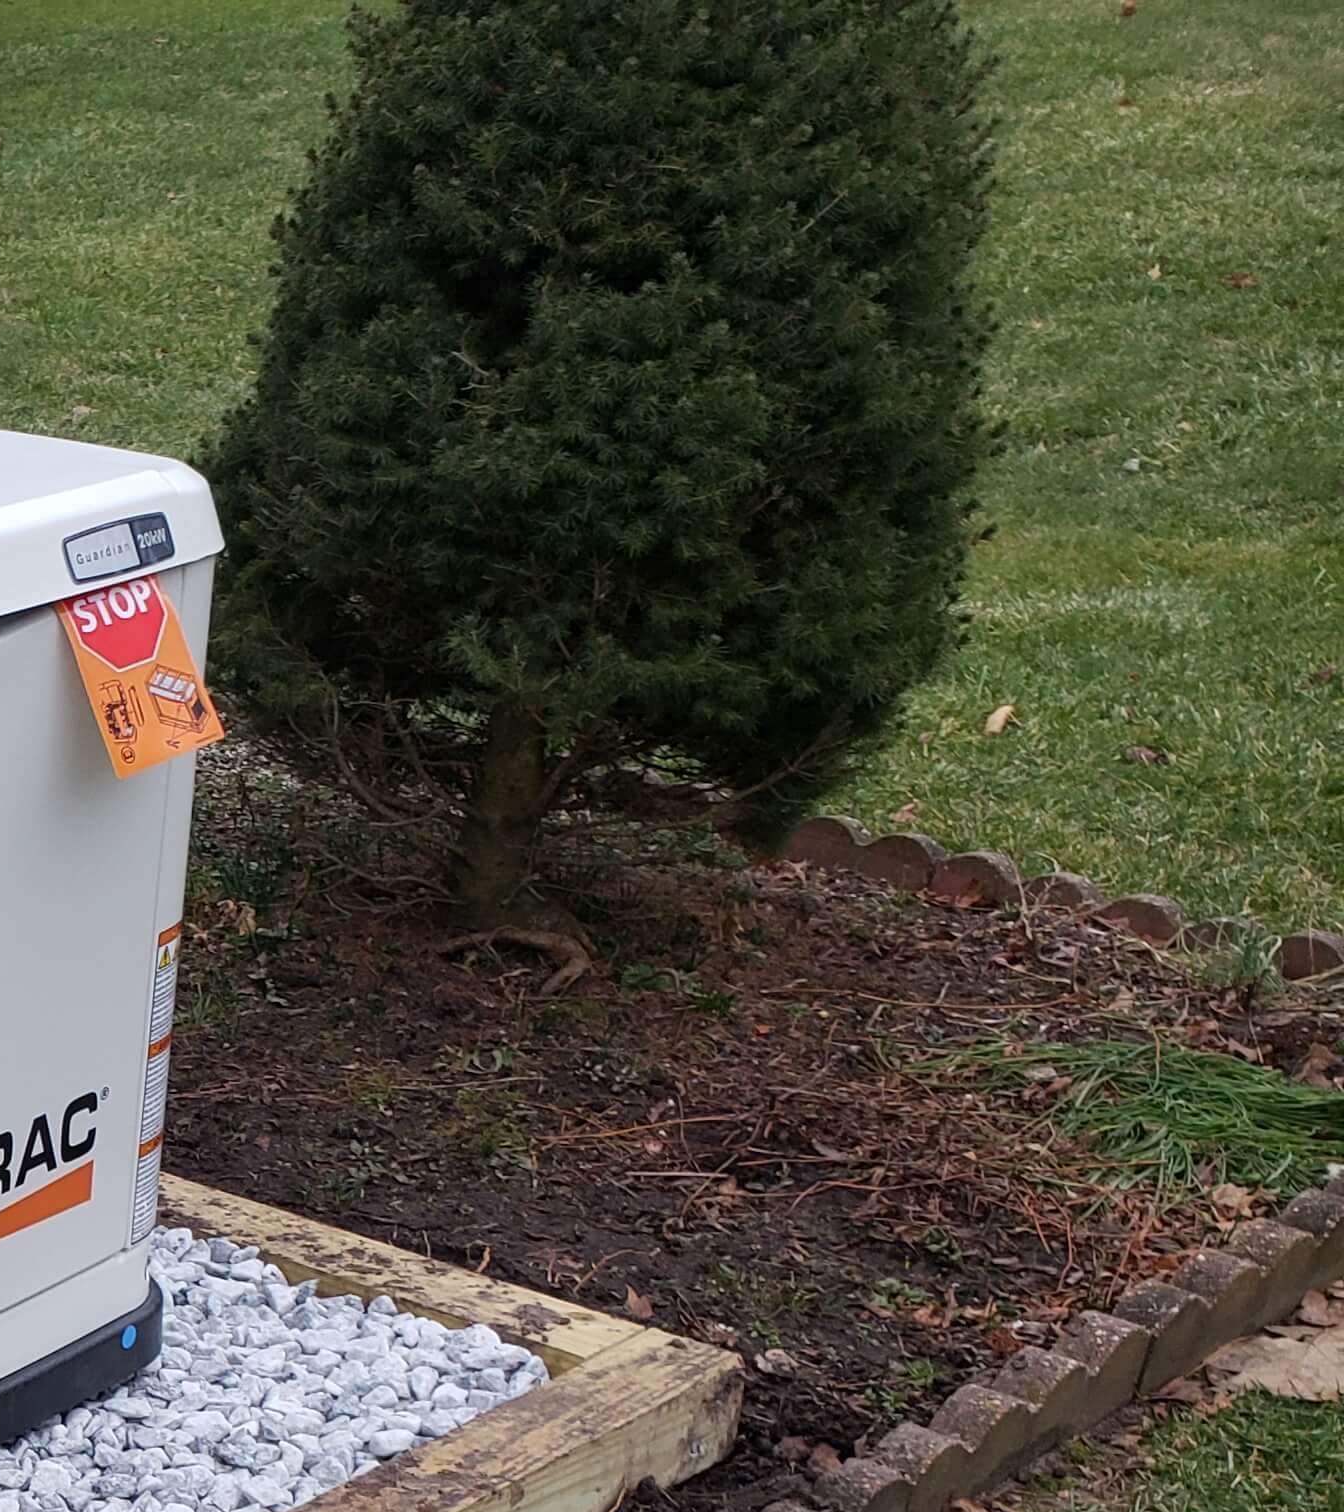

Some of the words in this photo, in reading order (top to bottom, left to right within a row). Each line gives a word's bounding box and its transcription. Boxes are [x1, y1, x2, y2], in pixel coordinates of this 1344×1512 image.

[75, 541, 131, 565] Guardian
[137, 527, 166, 549] 20kW
[73, 578, 152, 634] STOP
